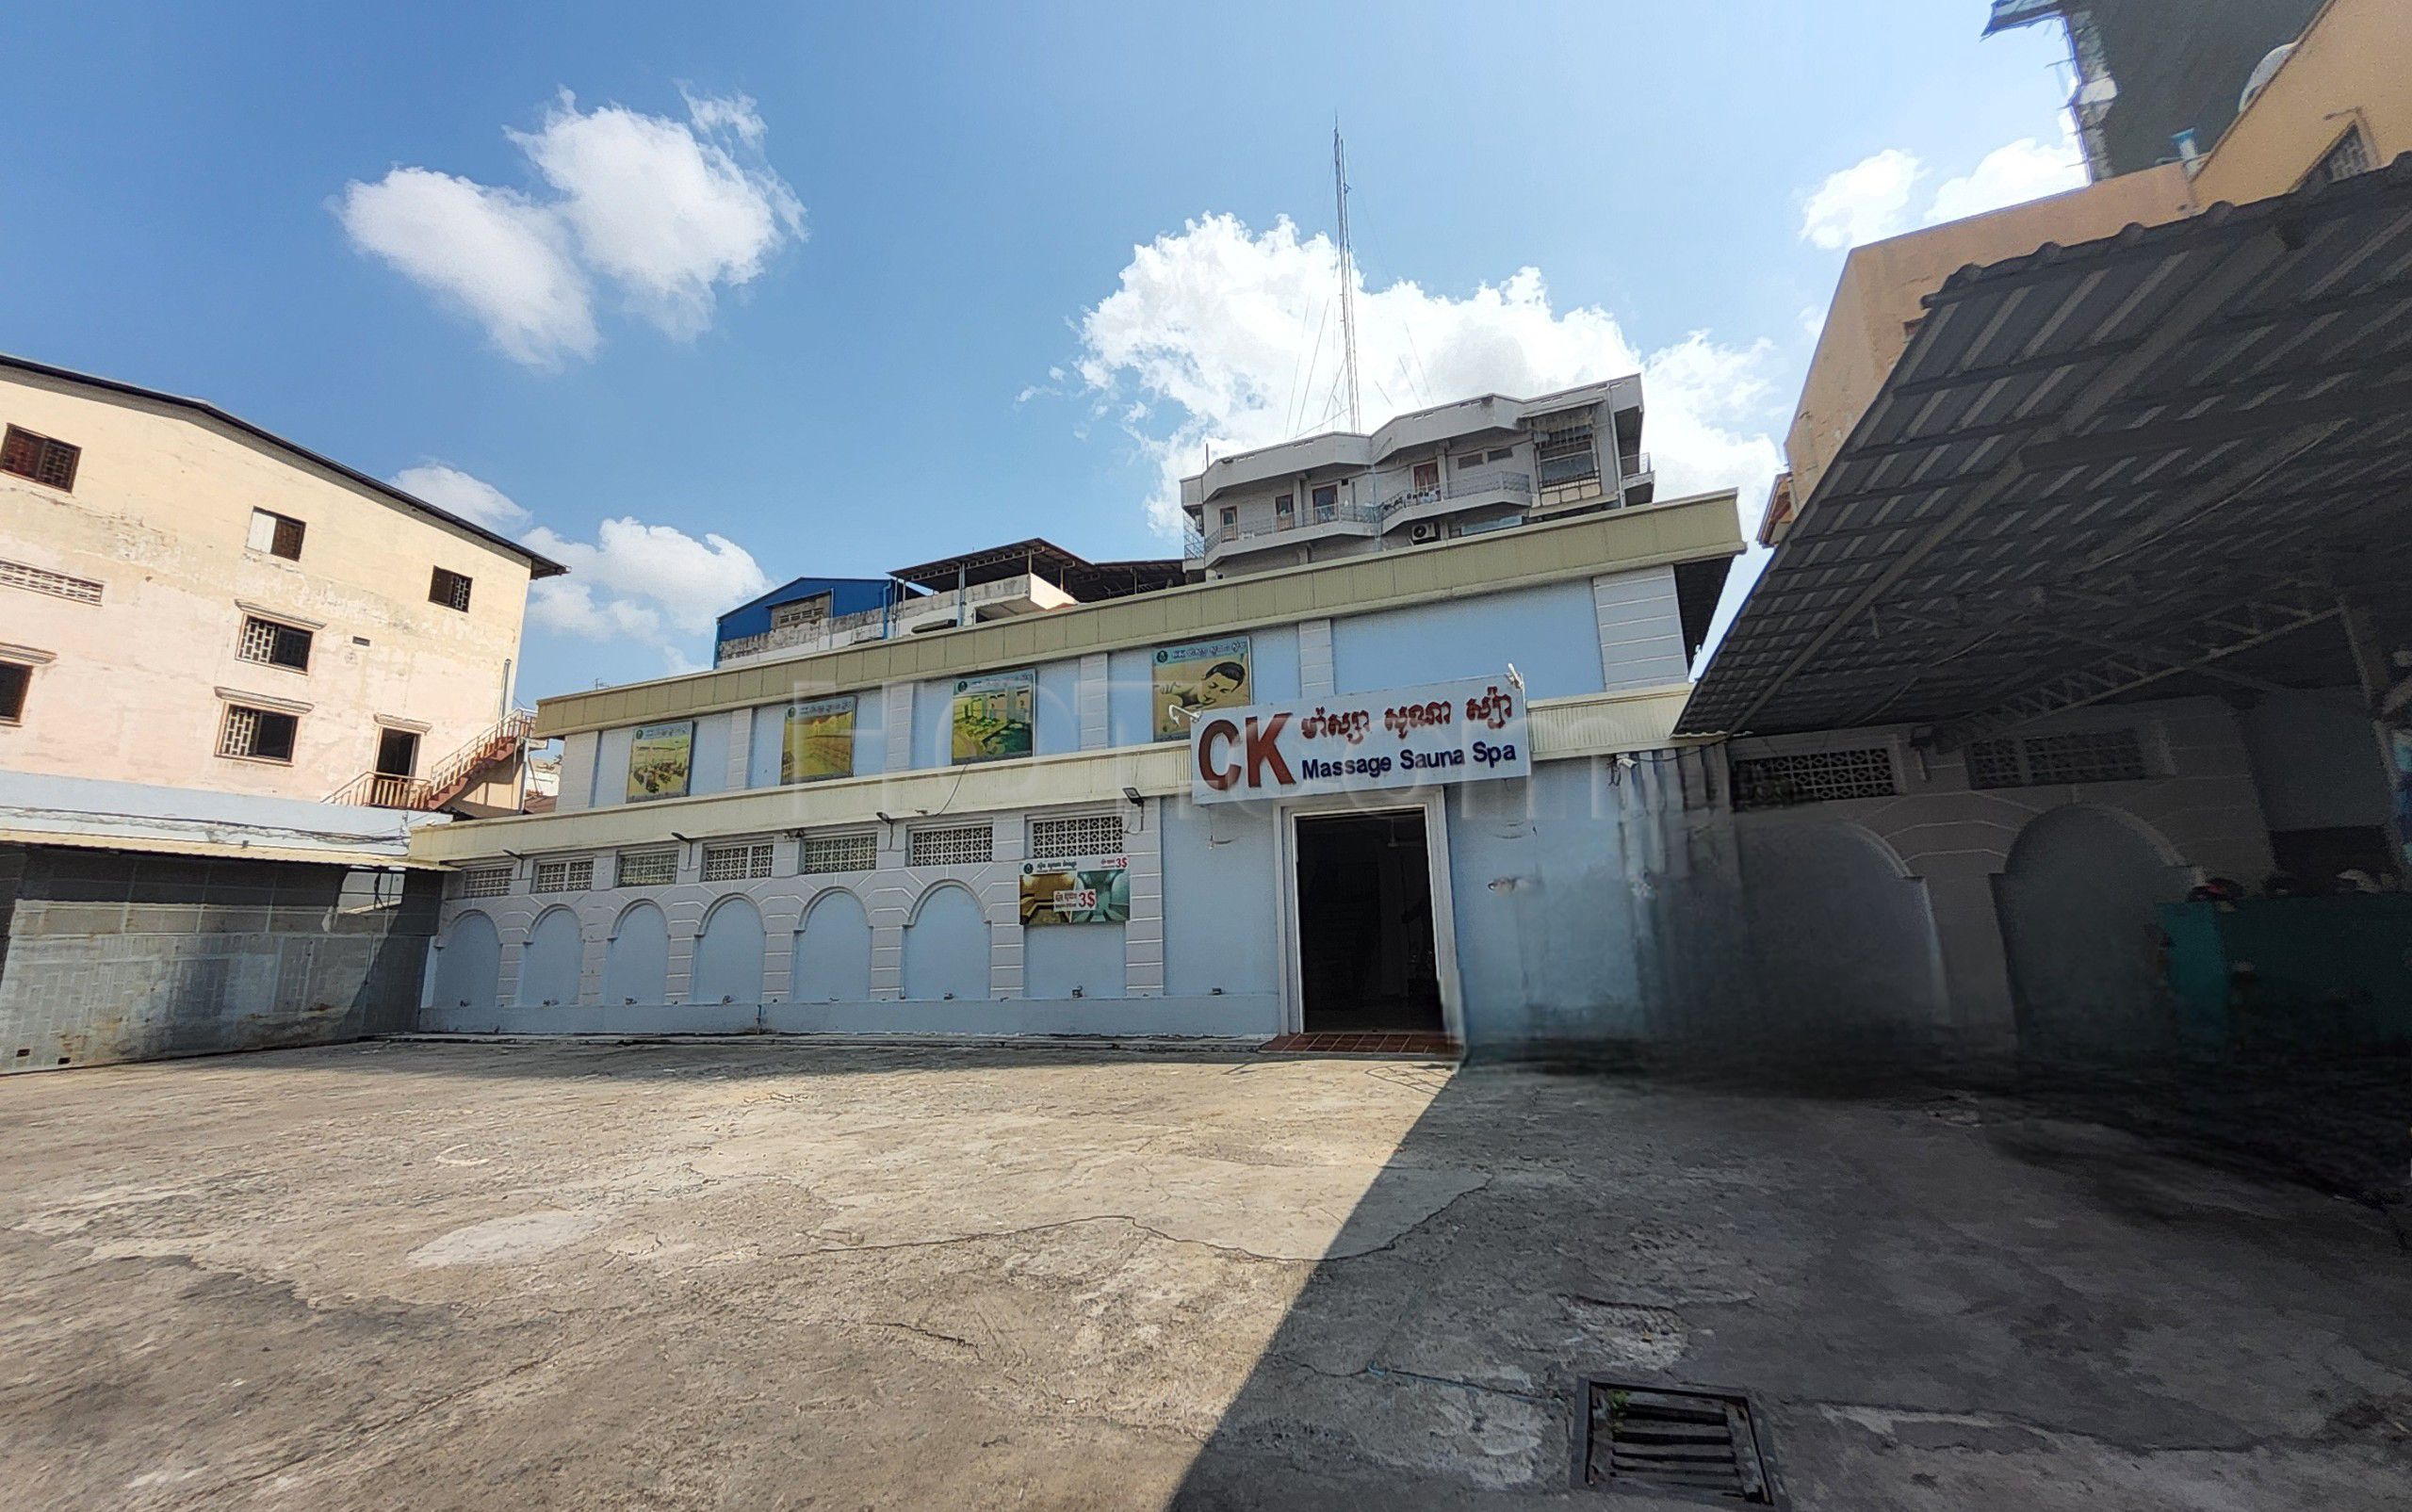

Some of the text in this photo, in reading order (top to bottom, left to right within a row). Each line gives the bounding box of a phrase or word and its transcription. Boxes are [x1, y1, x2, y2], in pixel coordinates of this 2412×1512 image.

[1384, 701, 1451, 740] សូណា
[1198, 712, 1296, 791] CK
[1302, 741, 1516, 779] Massage Sauna Spa
[1116, 857, 1128, 869] 3$
[1078, 890, 1096, 909] 3$
